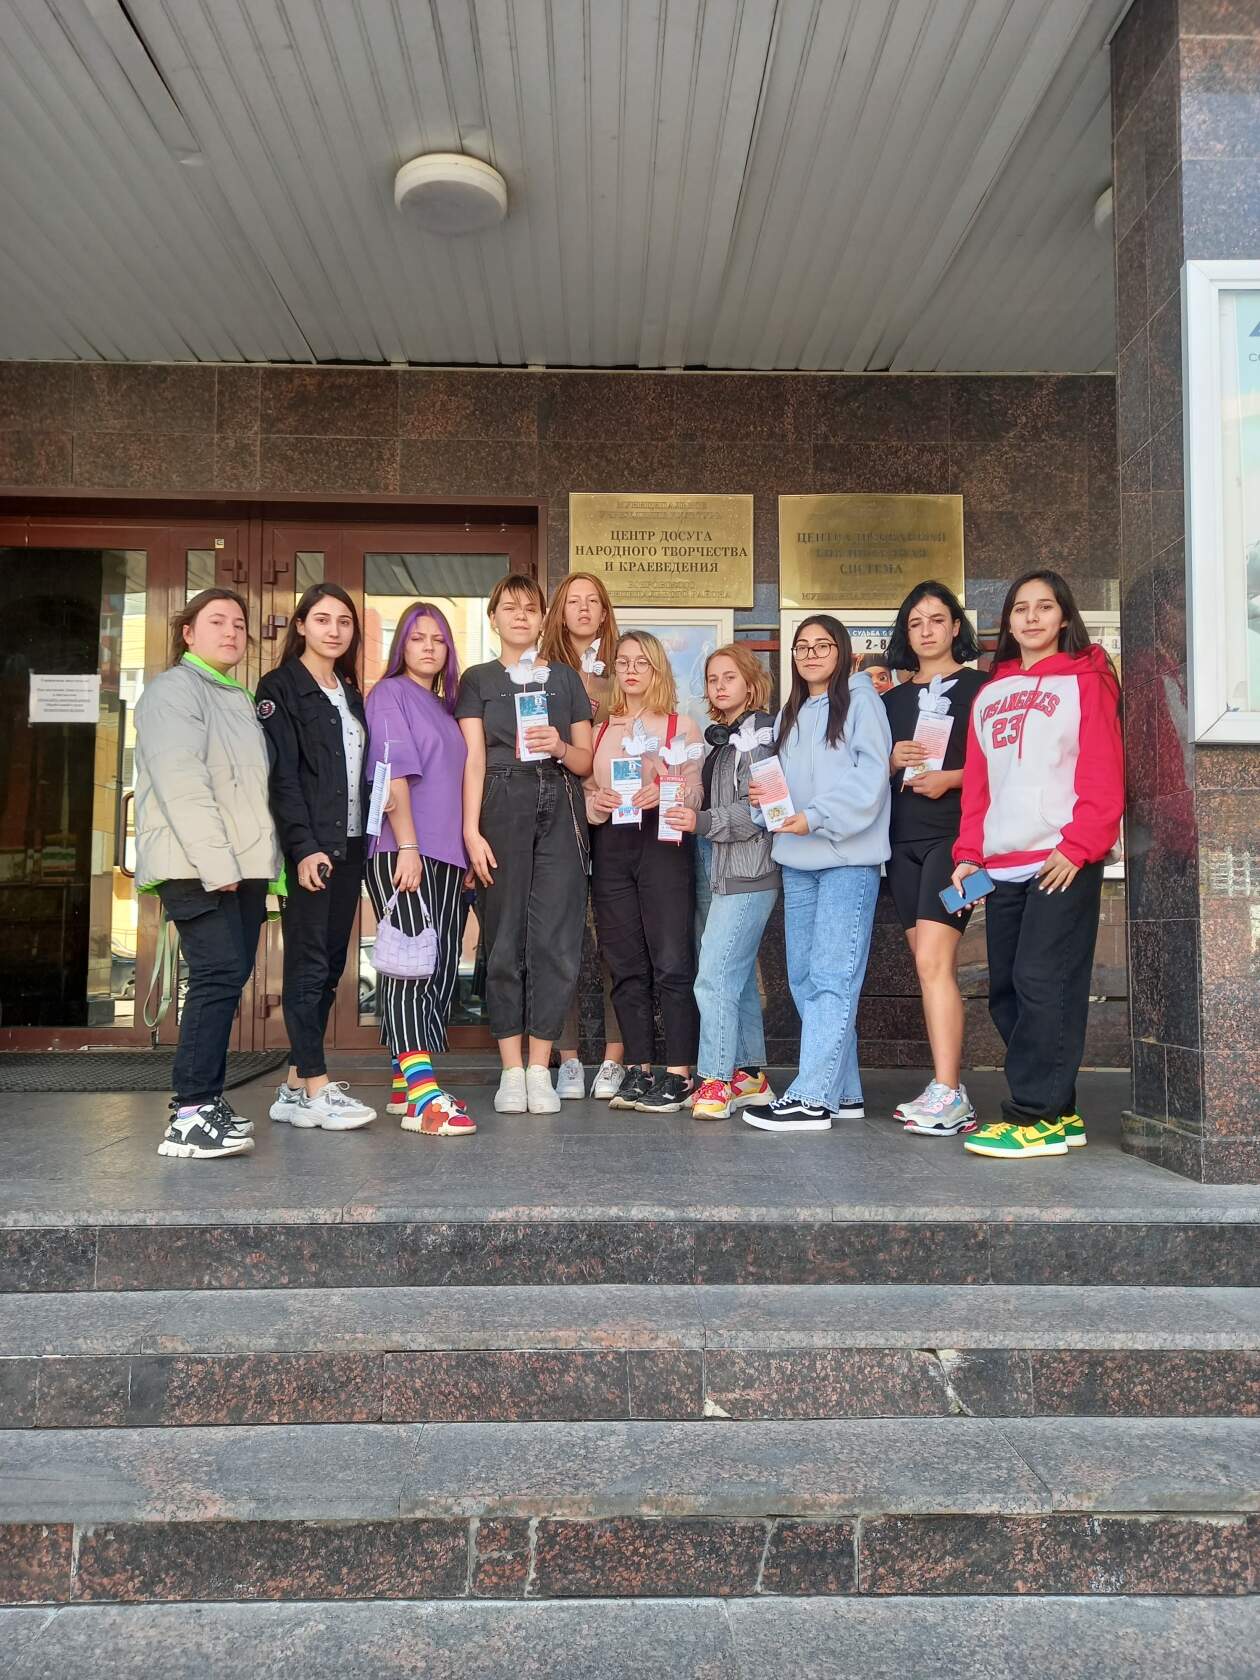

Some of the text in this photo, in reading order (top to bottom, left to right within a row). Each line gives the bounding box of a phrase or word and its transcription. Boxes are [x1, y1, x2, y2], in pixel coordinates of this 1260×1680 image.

[610, 530, 713, 543] ЦЕНТР ДОСУГА
[575, 545, 748, 557] НАРОДНОГО ТВОРЧЕСТВА
[605, 562, 718, 574] И КРАЕВЕДЕНИЯ
[992, 713, 1024, 749] 23
